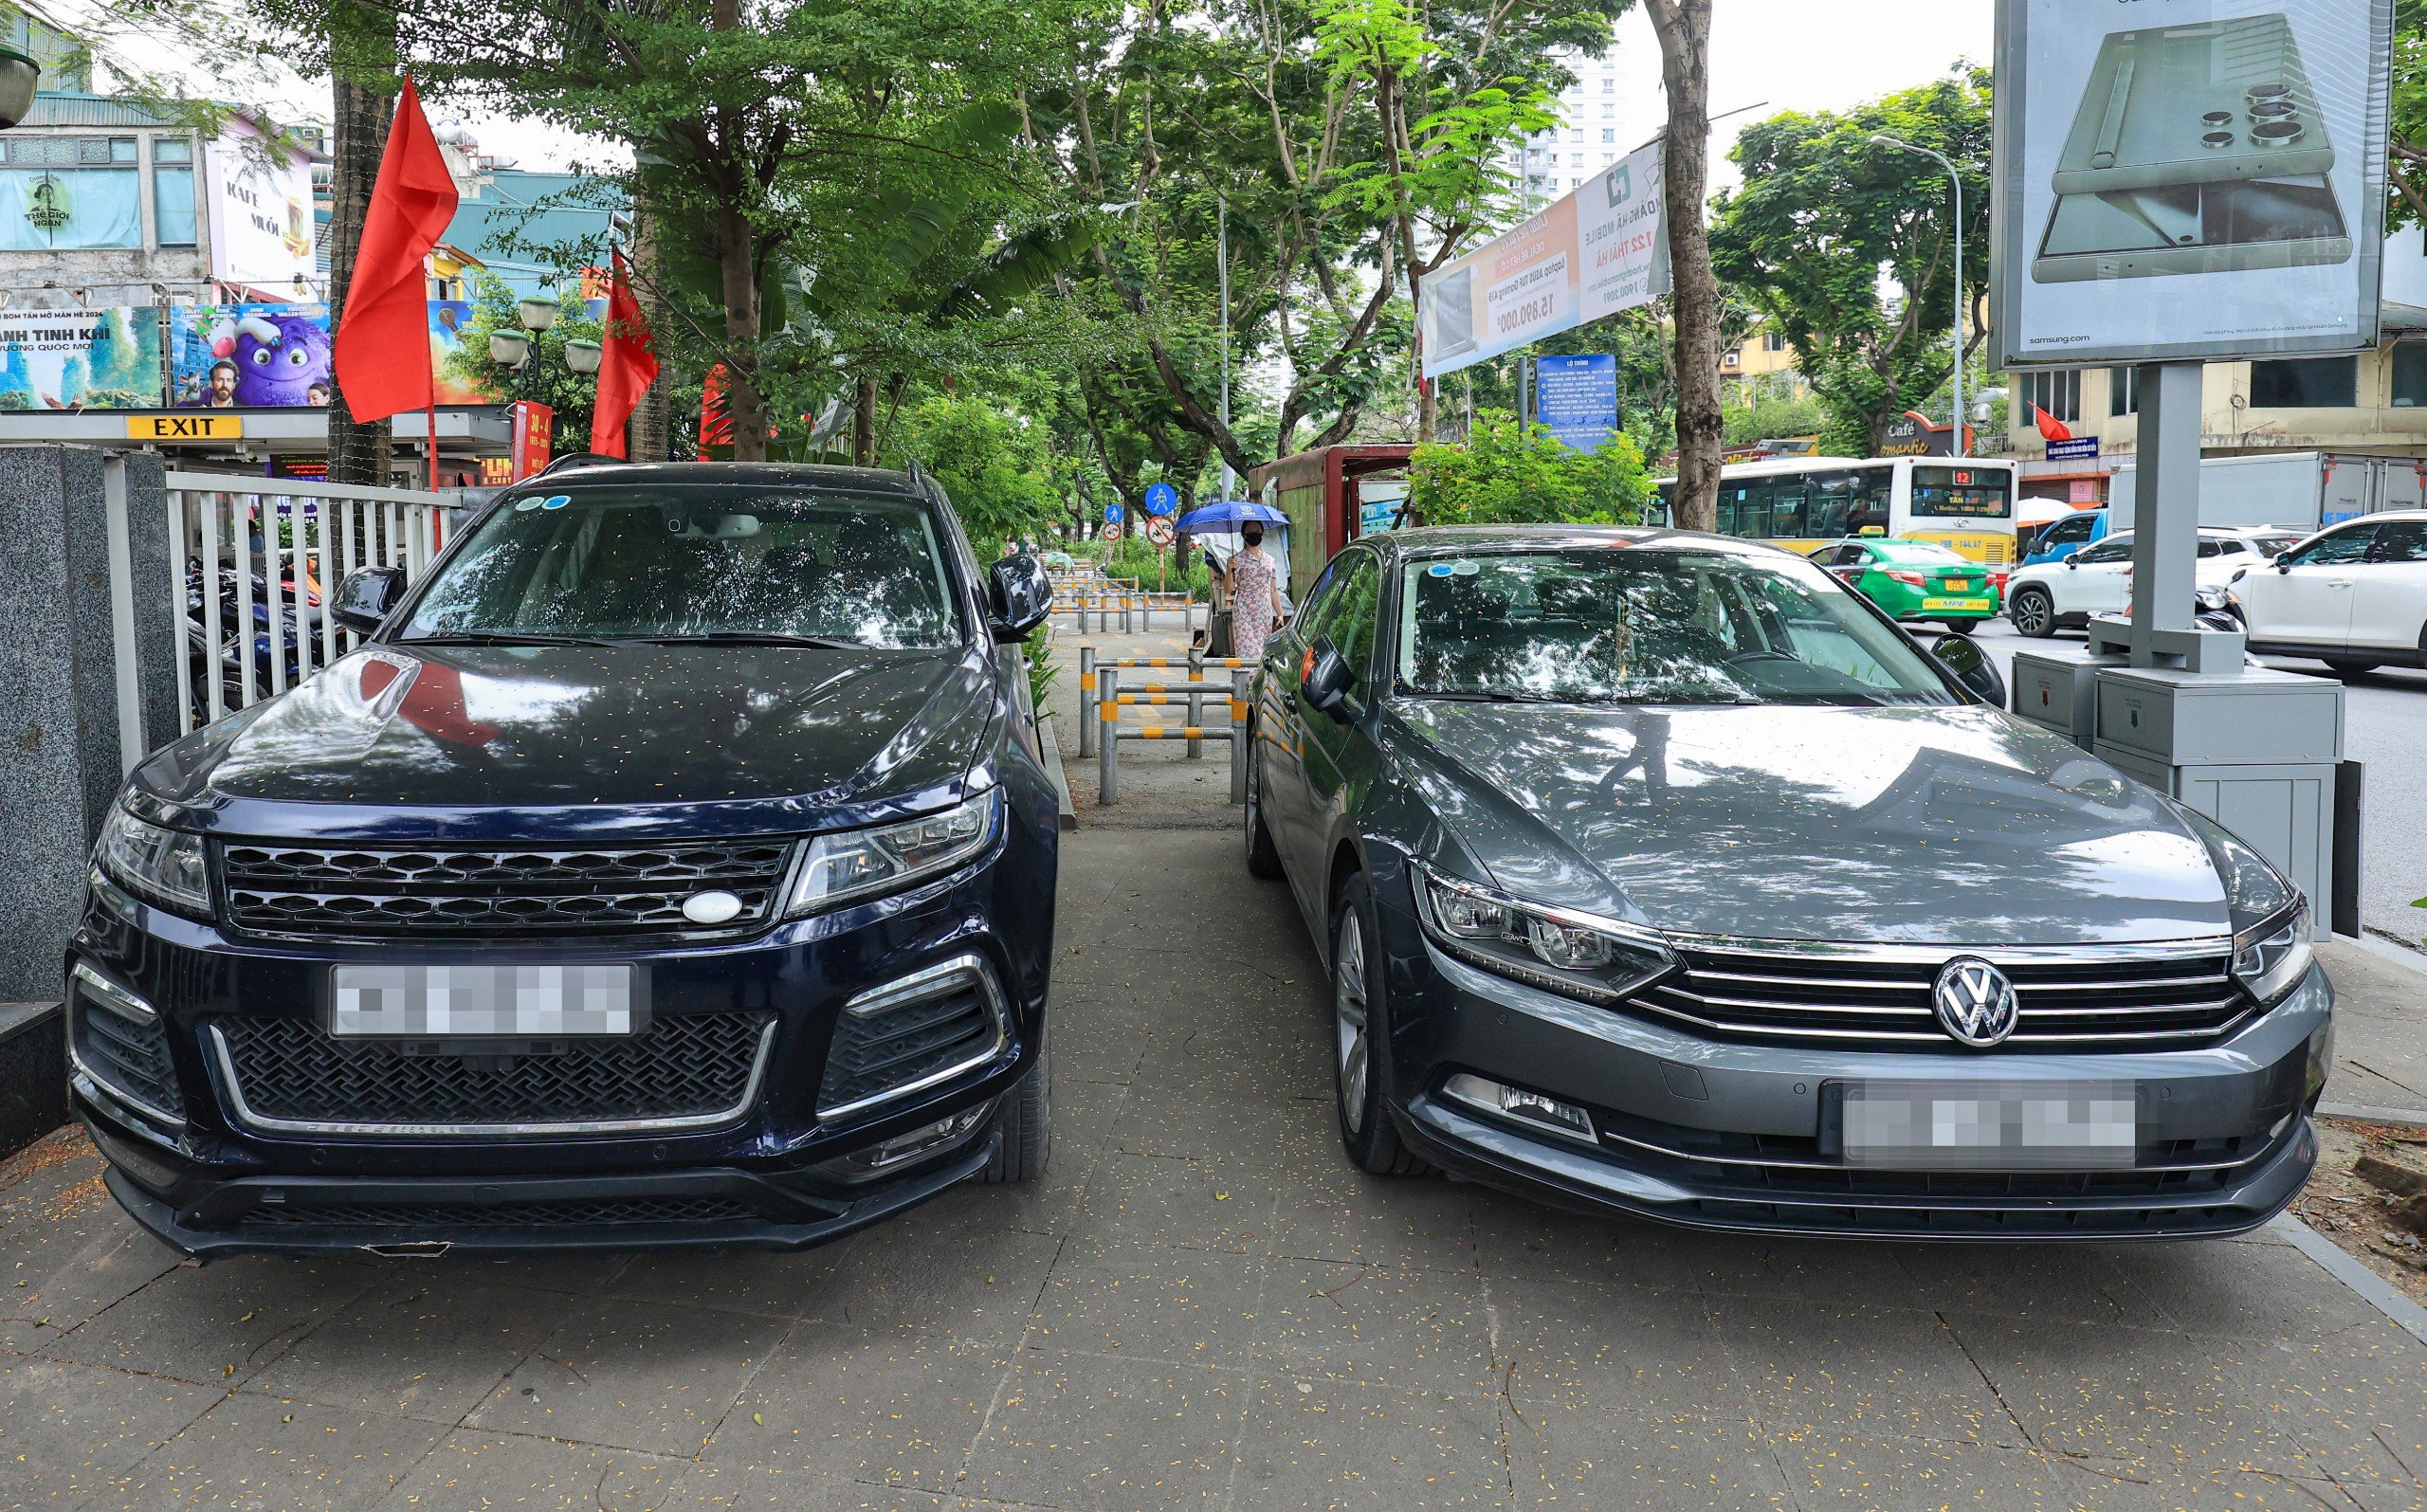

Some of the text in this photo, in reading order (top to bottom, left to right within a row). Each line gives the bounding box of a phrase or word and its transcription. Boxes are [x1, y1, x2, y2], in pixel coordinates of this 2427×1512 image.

[228, 181, 260, 209] KAFE
[32, 329, 74, 341] TINH
[80, 323, 110, 339] KHỈ
[2030, 336, 2089, 344] samsung.com
[154, 419, 214, 436] EXIT
[531, 413, 539, 433] 30
[543, 418, 549, 435] 4
[1888, 422, 1914, 437] Café
[1881, 439, 1928, 455] omantic
[1957, 473, 1969, 483] 12
